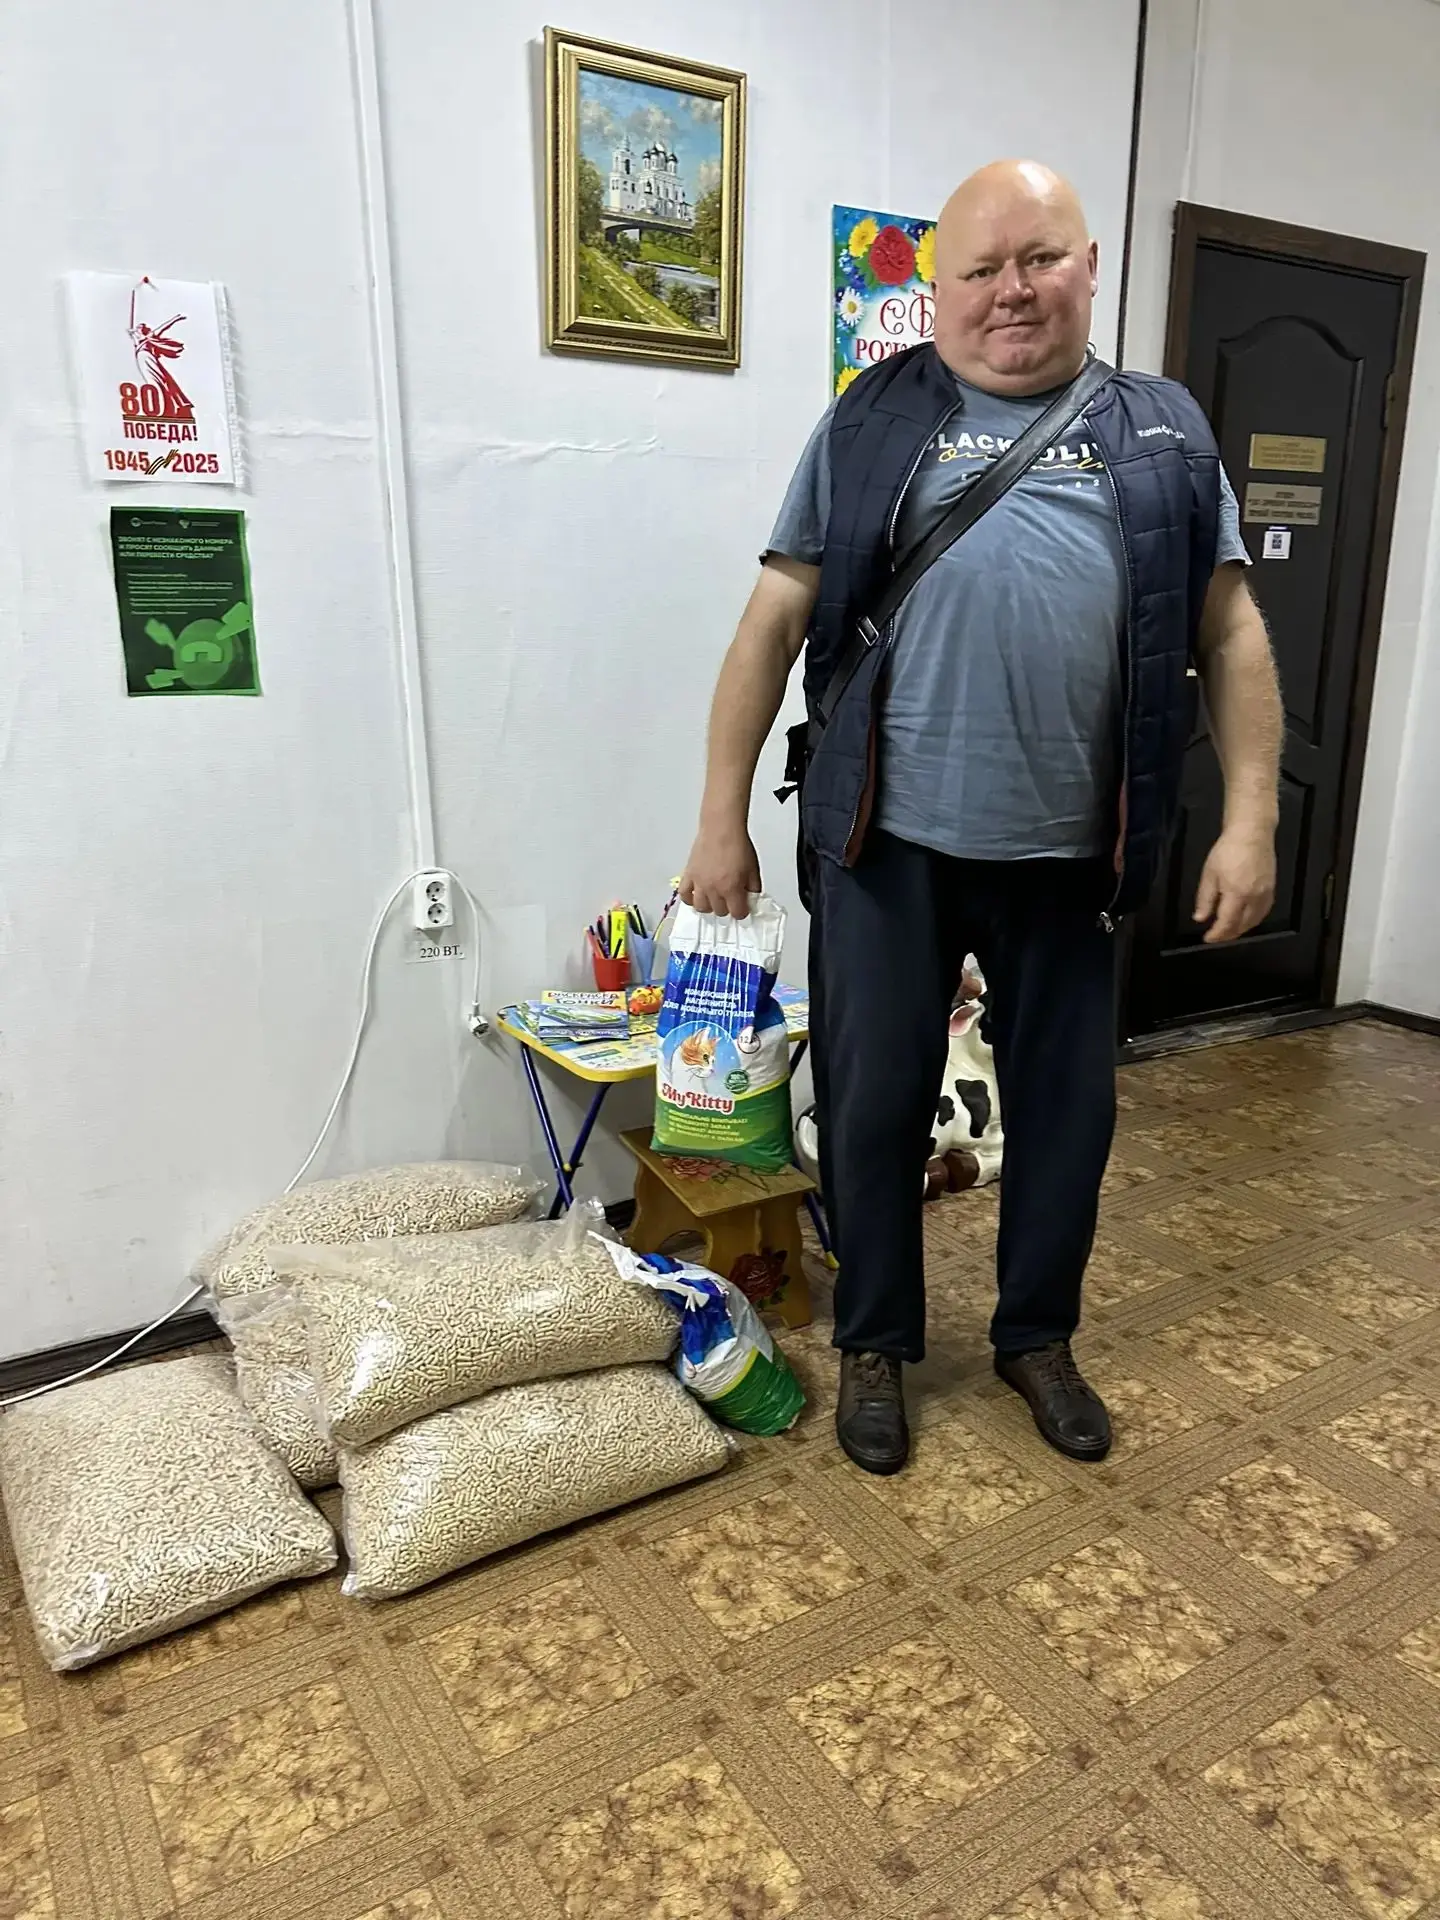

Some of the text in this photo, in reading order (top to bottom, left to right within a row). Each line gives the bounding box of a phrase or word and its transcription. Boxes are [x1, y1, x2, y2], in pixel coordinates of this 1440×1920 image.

[119, 382, 161, 417] 80
[123, 422, 198, 443] ПОБЕДА!
[928, 433, 1016, 452] LACK
[104, 450, 220, 474] 1945 2025
[420, 945, 463, 958] 220 ВТ.
[662, 1000, 680, 1010] ДЛЯ
